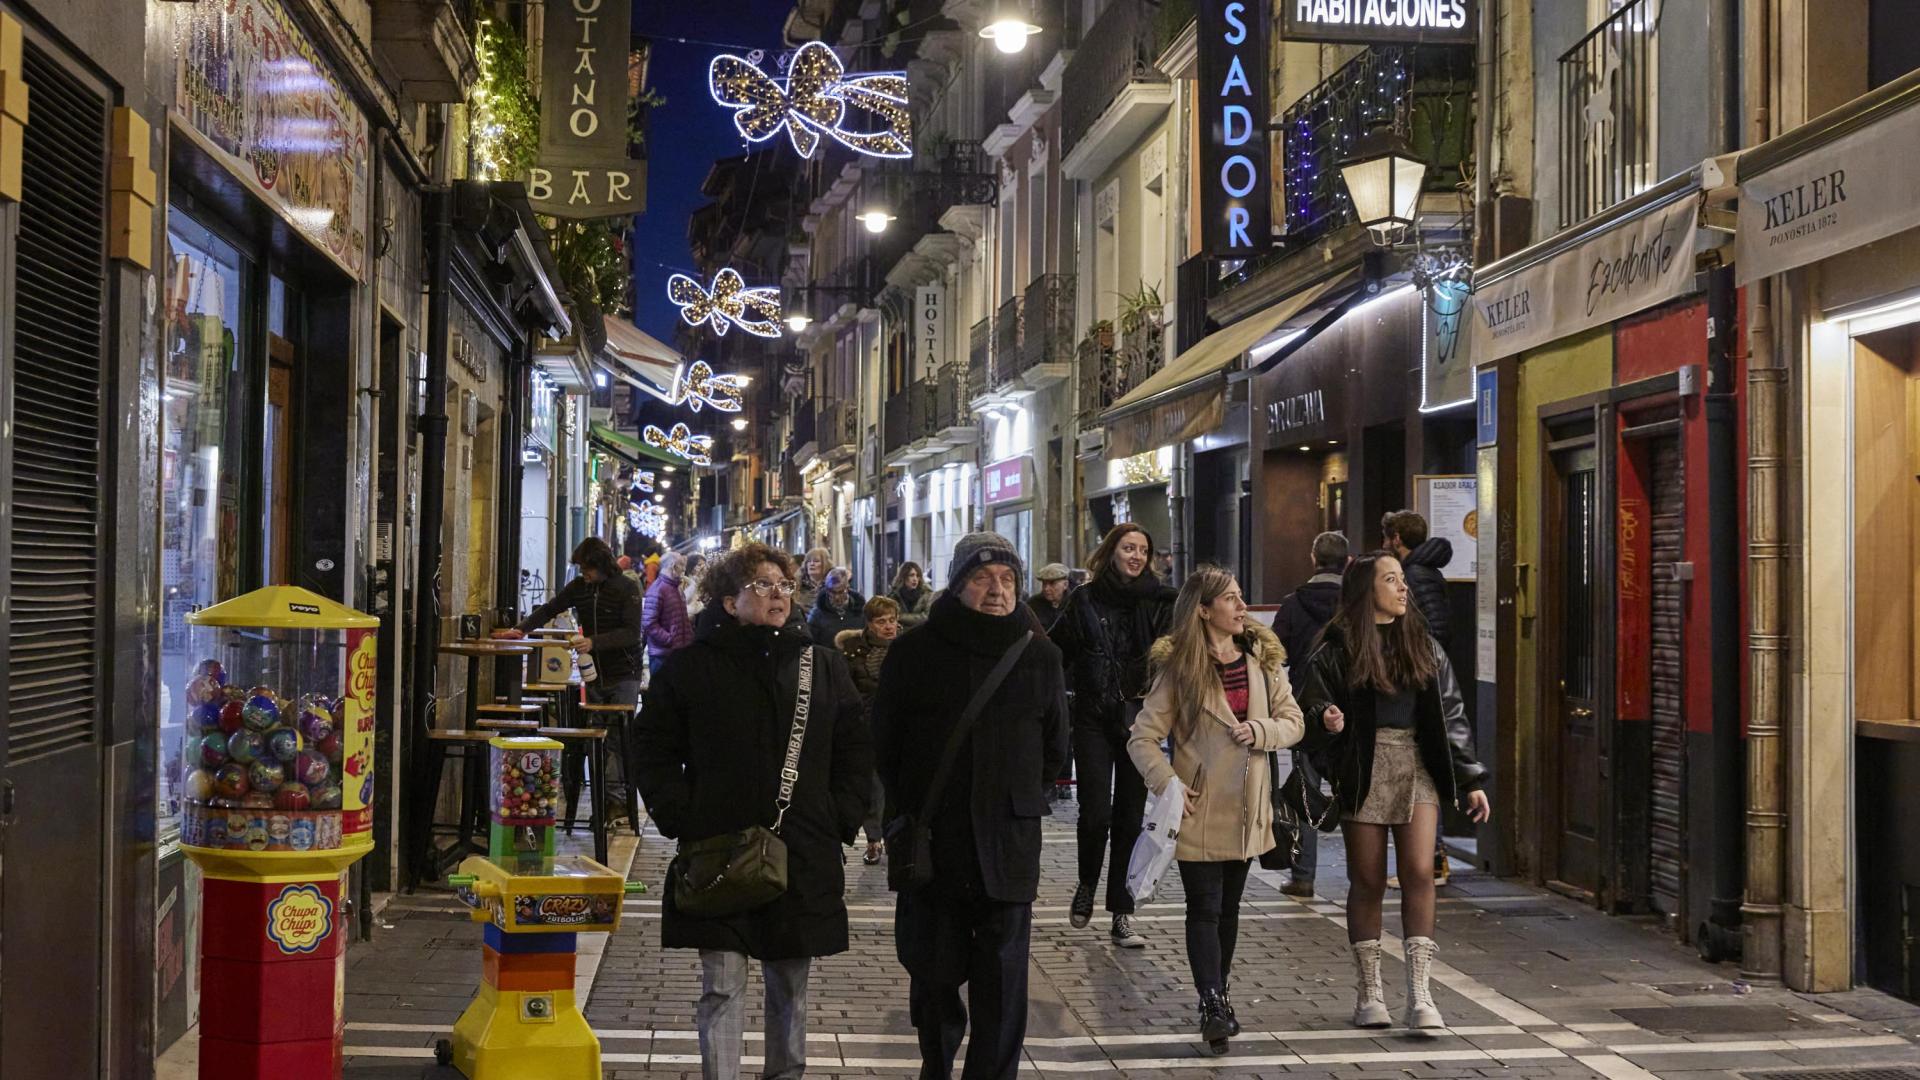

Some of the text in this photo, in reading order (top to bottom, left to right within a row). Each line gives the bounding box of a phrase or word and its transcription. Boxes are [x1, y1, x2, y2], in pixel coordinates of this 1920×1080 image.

[1296, 0, 1466, 28] HABITACIONES
[1220, 2, 1256, 248] SADOR
[527, 168, 632, 204] BAR
[1762, 169, 1847, 231] KELER
[1769, 220, 1817, 247] DONOSTIA
[1486, 290, 1530, 328] KELER
[924, 293, 938, 379] HOSTAL
[1433, 481, 1457, 489] ASADOR
[525, 756, 539, 769] 1€
[282, 905, 318, 919] Chupa
[543, 896, 589, 913] CRAZY
[280, 917, 316, 937] Chups
